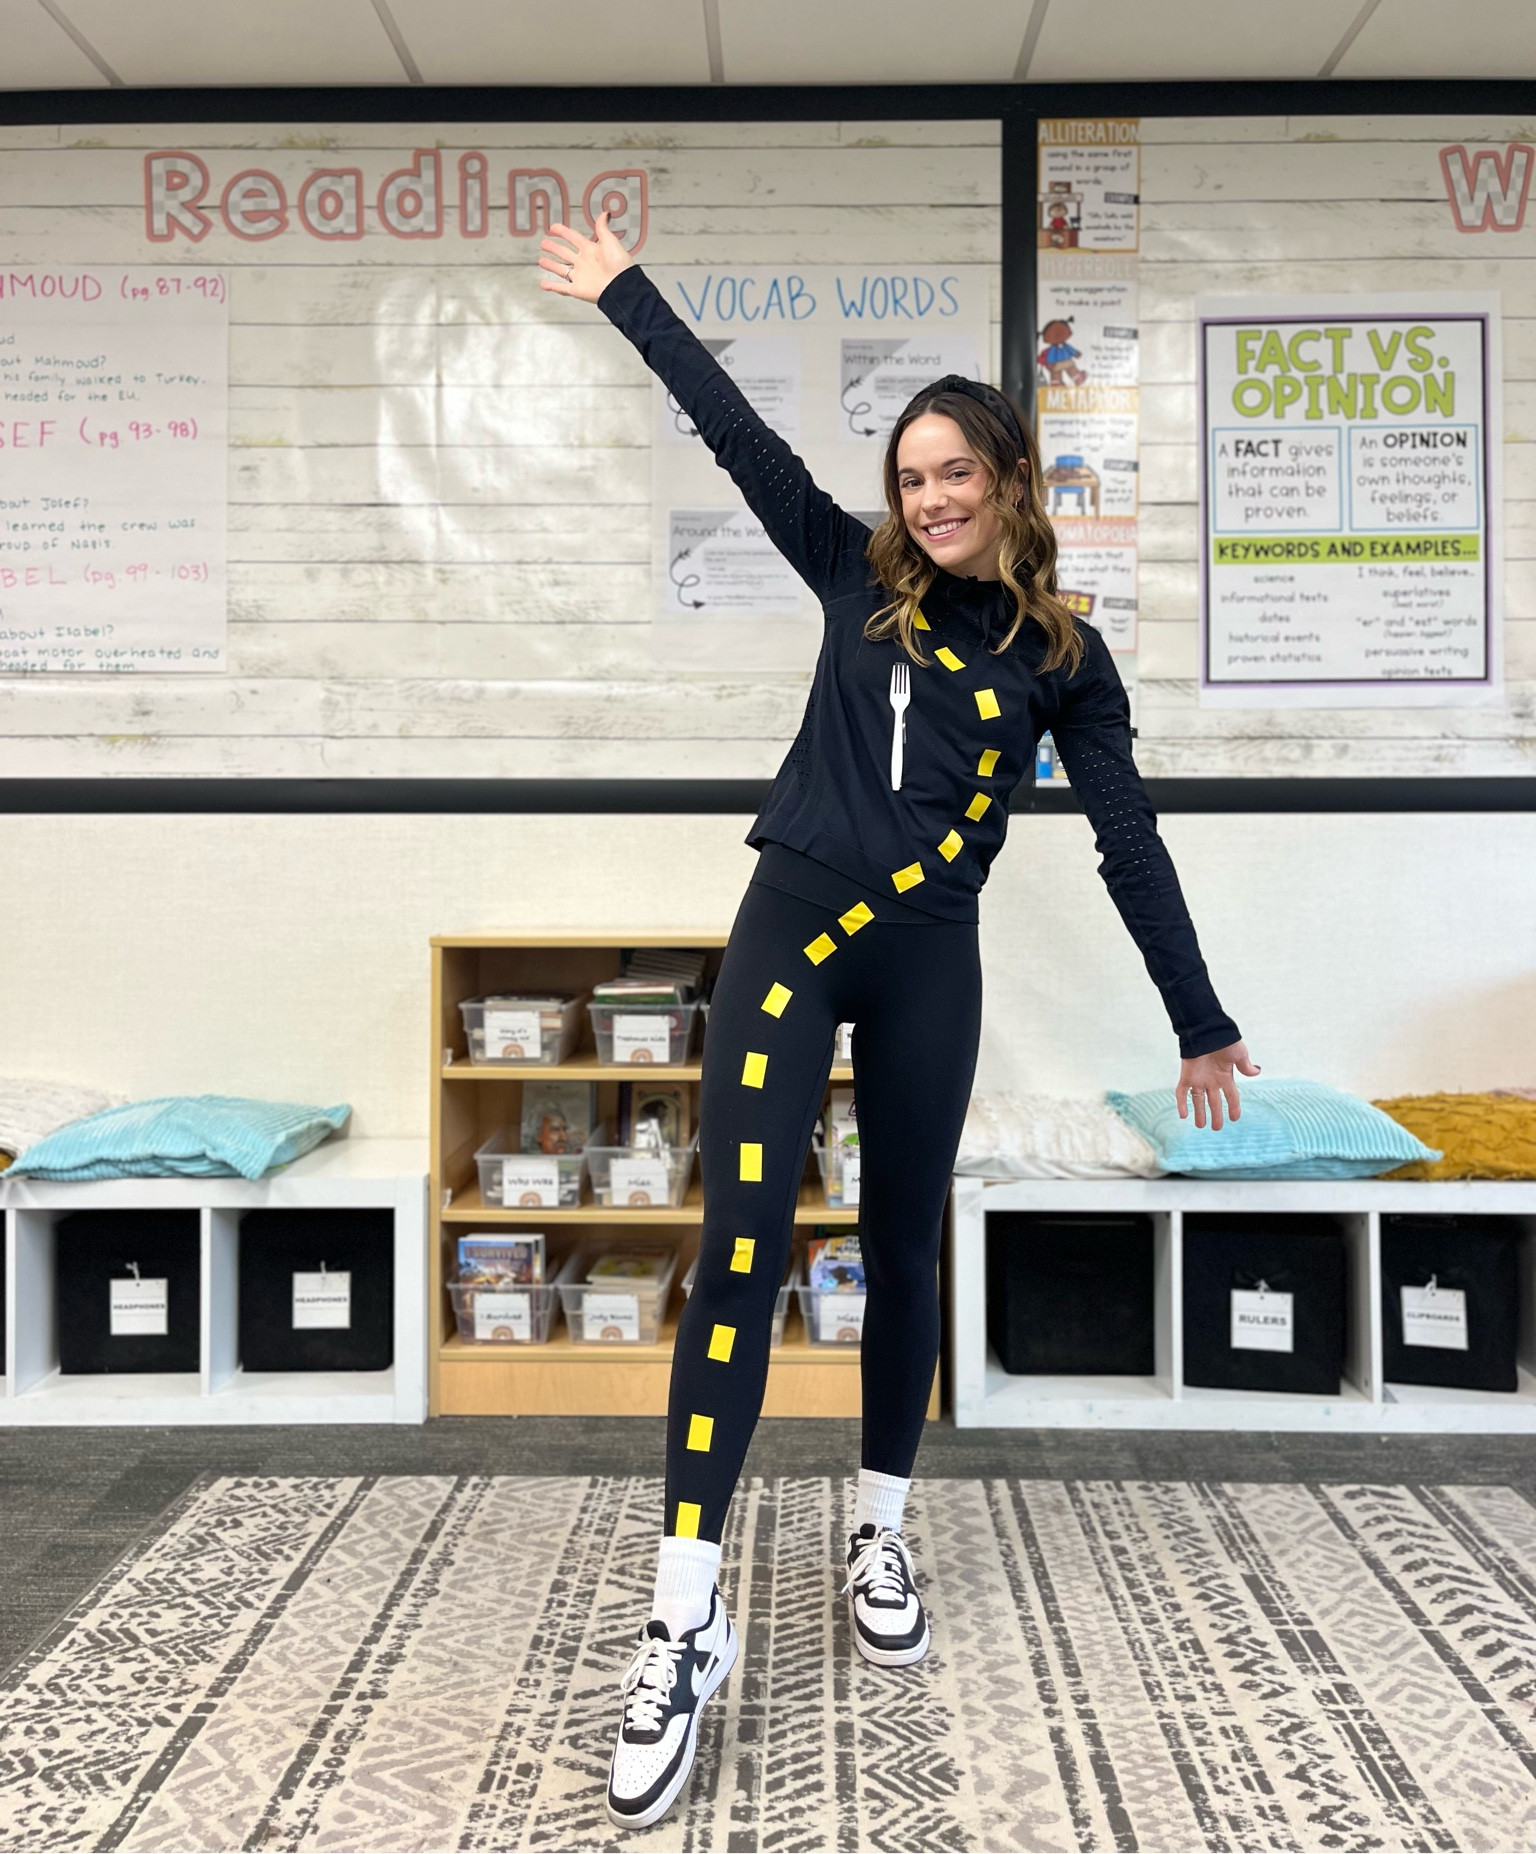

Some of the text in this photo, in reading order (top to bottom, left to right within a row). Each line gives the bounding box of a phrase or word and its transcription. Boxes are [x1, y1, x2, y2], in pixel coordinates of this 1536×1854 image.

[1439, 143, 1535, 234] W
[145, 148, 648, 257] Reading
[0, 273, 102, 301] MOUD
[677, 275, 959, 322] VOCAB WORDS
[1236, 326, 1450, 374] FACT VS.
[35, 354, 107, 370] Mahmoud?
[883, 353, 904, 366] the
[908, 353, 941, 366] Word
[28, 370, 66, 386] family
[75, 374, 122, 385] walked
[133, 373, 146, 383] to
[5, 390, 49, 402] headed
[58, 390, 76, 402] for
[88, 391, 108, 402] the
[1232, 371, 1455, 420] OPINION
[1359, 431, 1467, 449] An OPINION
[1218, 439, 1334, 462] A FACT gives
[1362, 453, 1464, 467] is someone's
[1227, 463, 1326, 477] information
[1356, 471, 1472, 489] own thoughts,
[1228, 482, 1327, 497] that can be
[1370, 490, 1459, 508] feelings, or
[1244, 505, 1309, 522] proven.
[1386, 508, 1444, 522] beliefs.
[6, 521, 66, 533] learned
[79, 521, 106, 533] the
[121, 520, 157, 531] crew
[672, 525, 717, 537] Around
[721, 527, 742, 537] the
[42, 538, 58, 550] of
[1218, 540, 1478, 559] KEYWORDS AND EXAMPLES...
[1253, 572, 1295, 584] science
[1220, 591, 1329, 604] informational texts
[1382, 586, 1451, 599] superlatives
[1258, 612, 1291, 624] dates
[1384, 615, 1405, 627] and
[1442, 614, 1478, 627] words
[1228, 631, 1321, 643] historical events
[37, 648, 83, 659] motor
[95, 648, 181, 659] overheated
[192, 648, 220, 659] and
[1227, 651, 1322, 665] proven statistics
[1364, 645, 1469, 658] persuasive writing
[63, 659, 86, 671] for
[1238, 1313, 1288, 1327] RULERS
[1406, 1311, 1461, 1322] CLIPBOARDS
